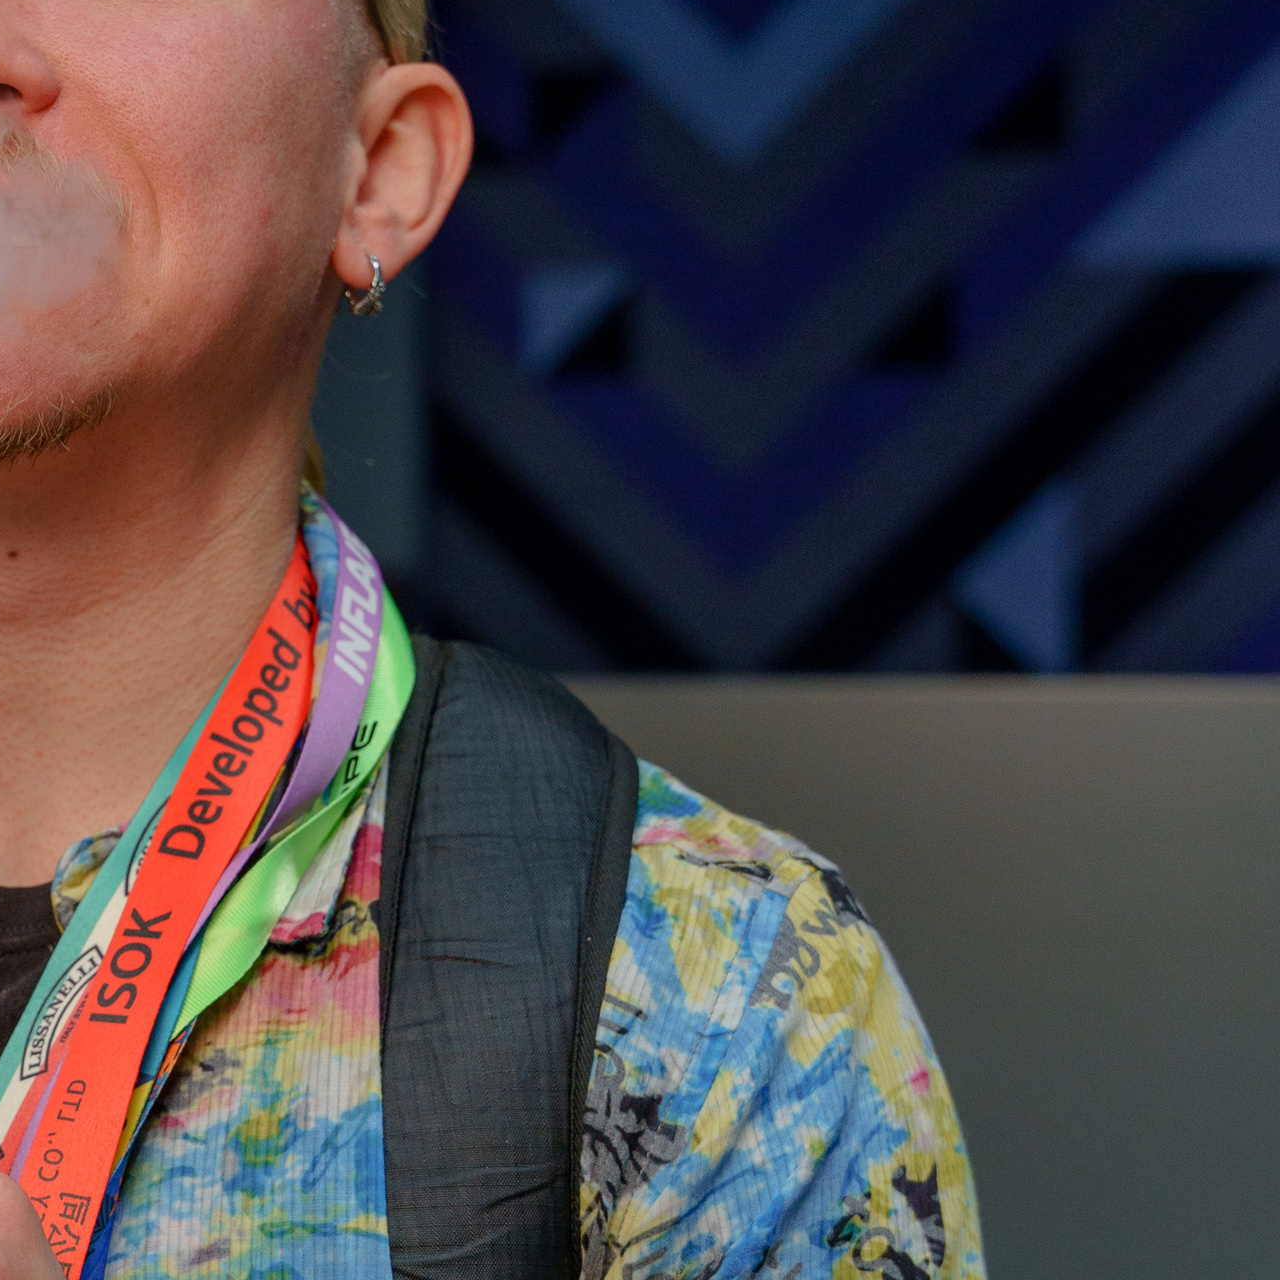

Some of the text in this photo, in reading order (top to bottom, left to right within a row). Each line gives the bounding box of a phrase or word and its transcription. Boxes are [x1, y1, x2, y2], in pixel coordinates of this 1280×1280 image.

[89, 626, 303, 1024] ISOK Developed
[29, 955, 99, 1073] LISSANELLI
